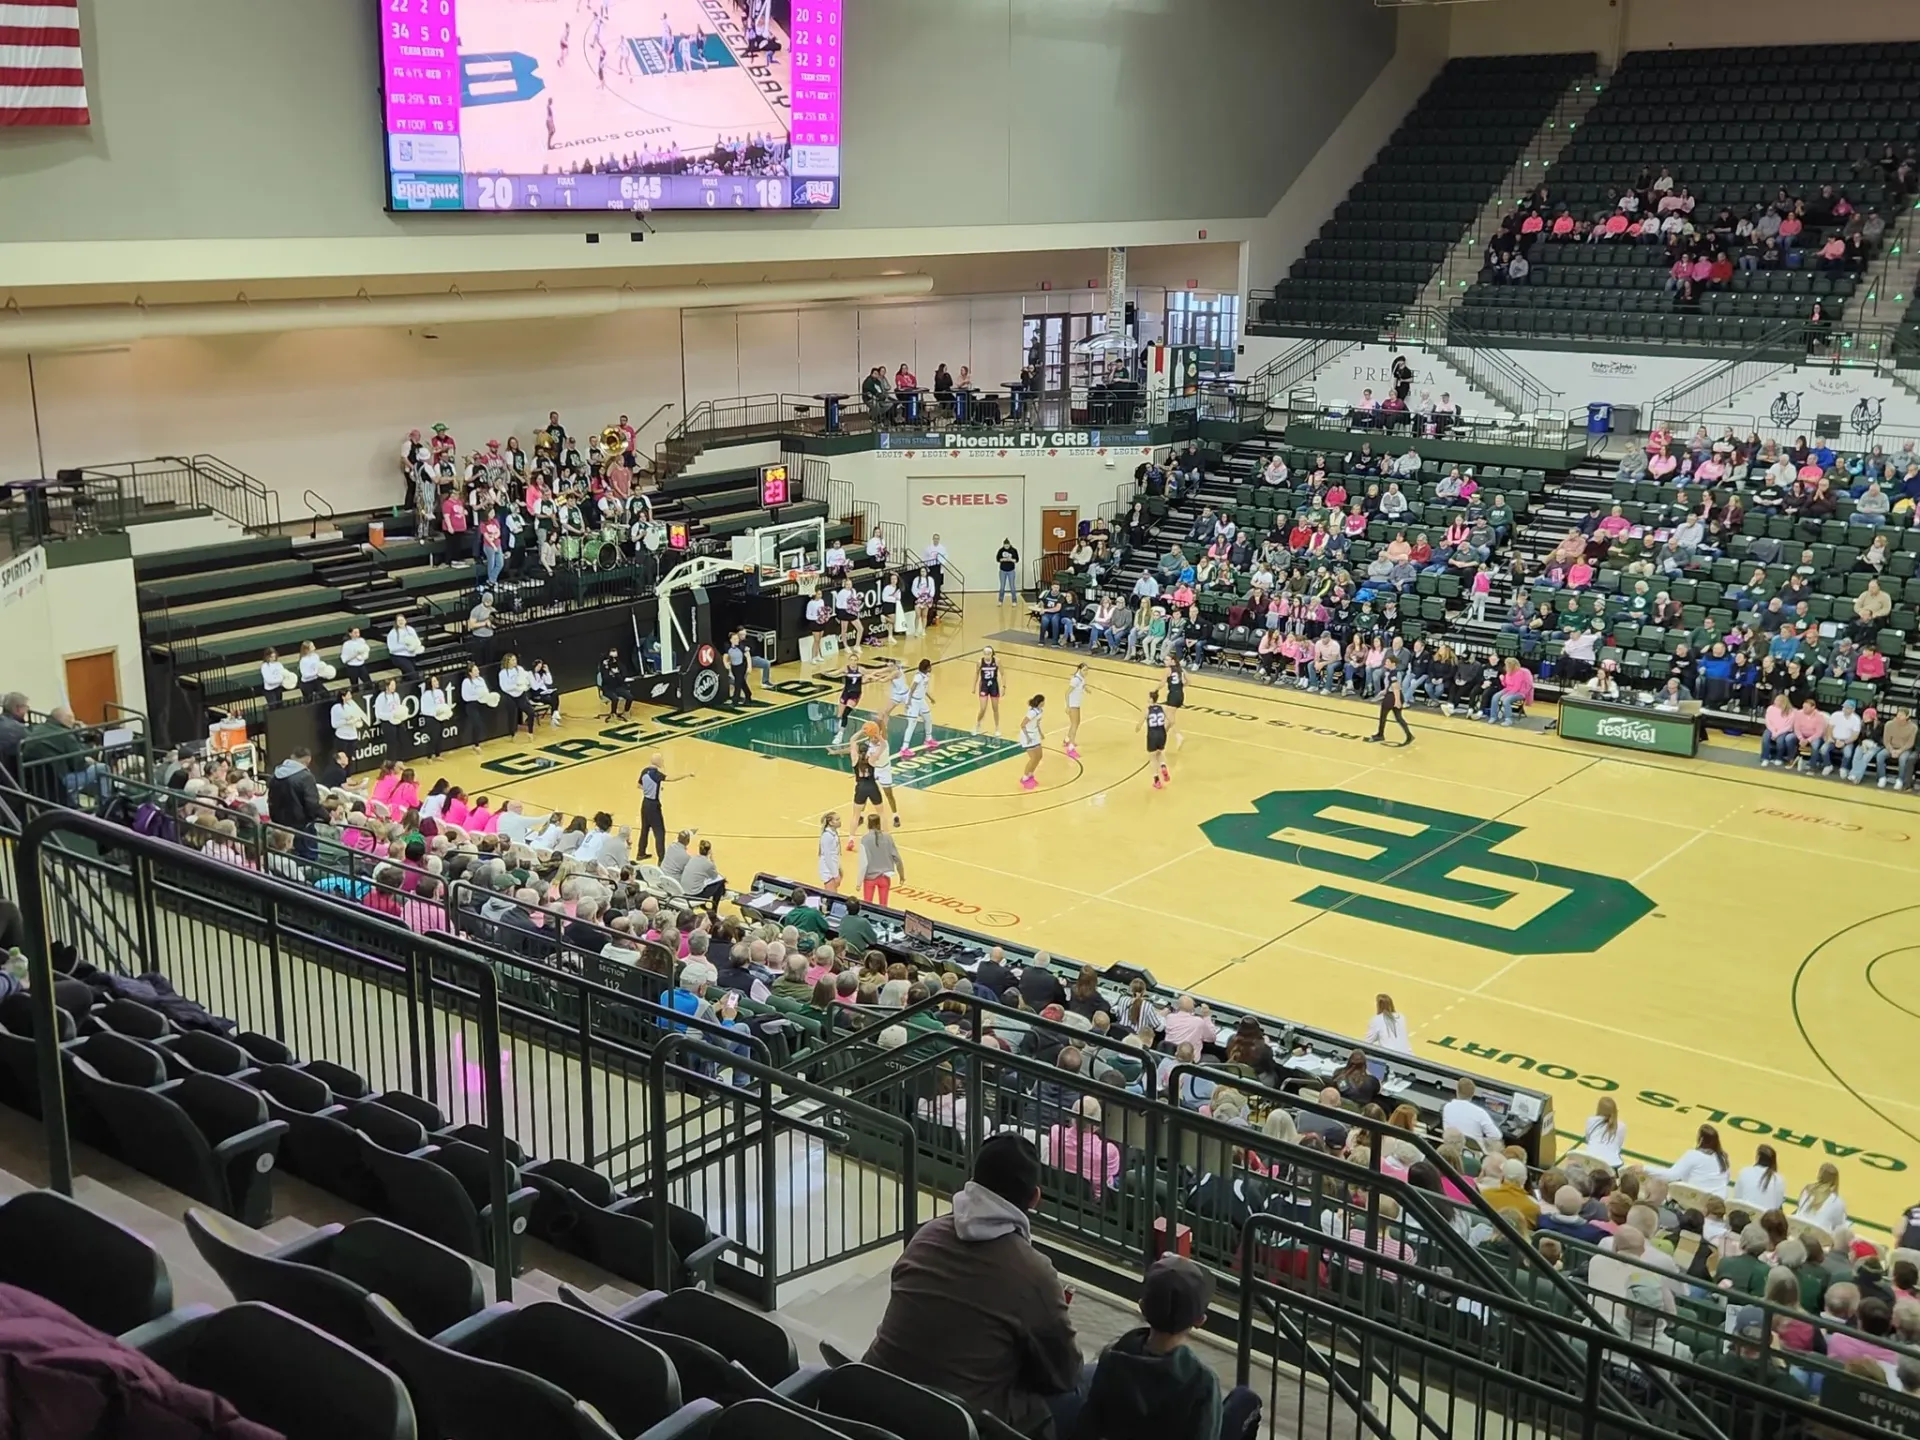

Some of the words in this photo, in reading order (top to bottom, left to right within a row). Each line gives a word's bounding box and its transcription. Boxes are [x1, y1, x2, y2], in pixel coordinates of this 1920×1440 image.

[440, 1, 449, 15] 0
[796, 8, 809, 22] 20
[817, 11, 823, 23] 5
[830, 12, 836, 24] 0
[391, 22, 409, 39] 34
[421, 26, 429, 41] 5
[441, 27, 450, 43] 0
[796, 30, 809, 45] 22
[829, 35, 836, 47] 0
[796, 52, 809, 66] 32
[816, 54, 822, 67] 3
[829, 56, 835, 68] 0
[397, 183, 459, 199] PHOENIX
[478, 177, 513, 208] 20
[620, 176, 662, 200] 6:45
[755, 179, 782, 208] 18
[563, 190, 571, 207] 1
[633, 199, 649, 209] 2ND
[706, 190, 715, 206] 0
[1353, 366, 1435, 385] PREEA
[945, 433, 1015, 448] Phoenix
[1020, 433, 1047, 448] Fly
[1051, 432, 1089, 446] GRB
[922, 493, 1008, 506] SCHEELS
[1, 556, 32, 589] SPIRITS
[702, 647, 714, 664] K
[983, 670, 994, 680] 21
[1171, 671, 1180, 685] 3
[1148, 712, 1165, 727] 22
[1596, 716, 1657, 744] festival
[889, 884, 982, 915] Capital
[598, 963, 626, 978] SECTION
[604, 977, 620, 992] 112
[1425, 1034, 1620, 1093] COURT
[1635, 1089, 1908, 1173] CAROL'S
[1858, 1391, 1920, 1420] SECTION
[1870, 1415, 1905, 1435] 111
